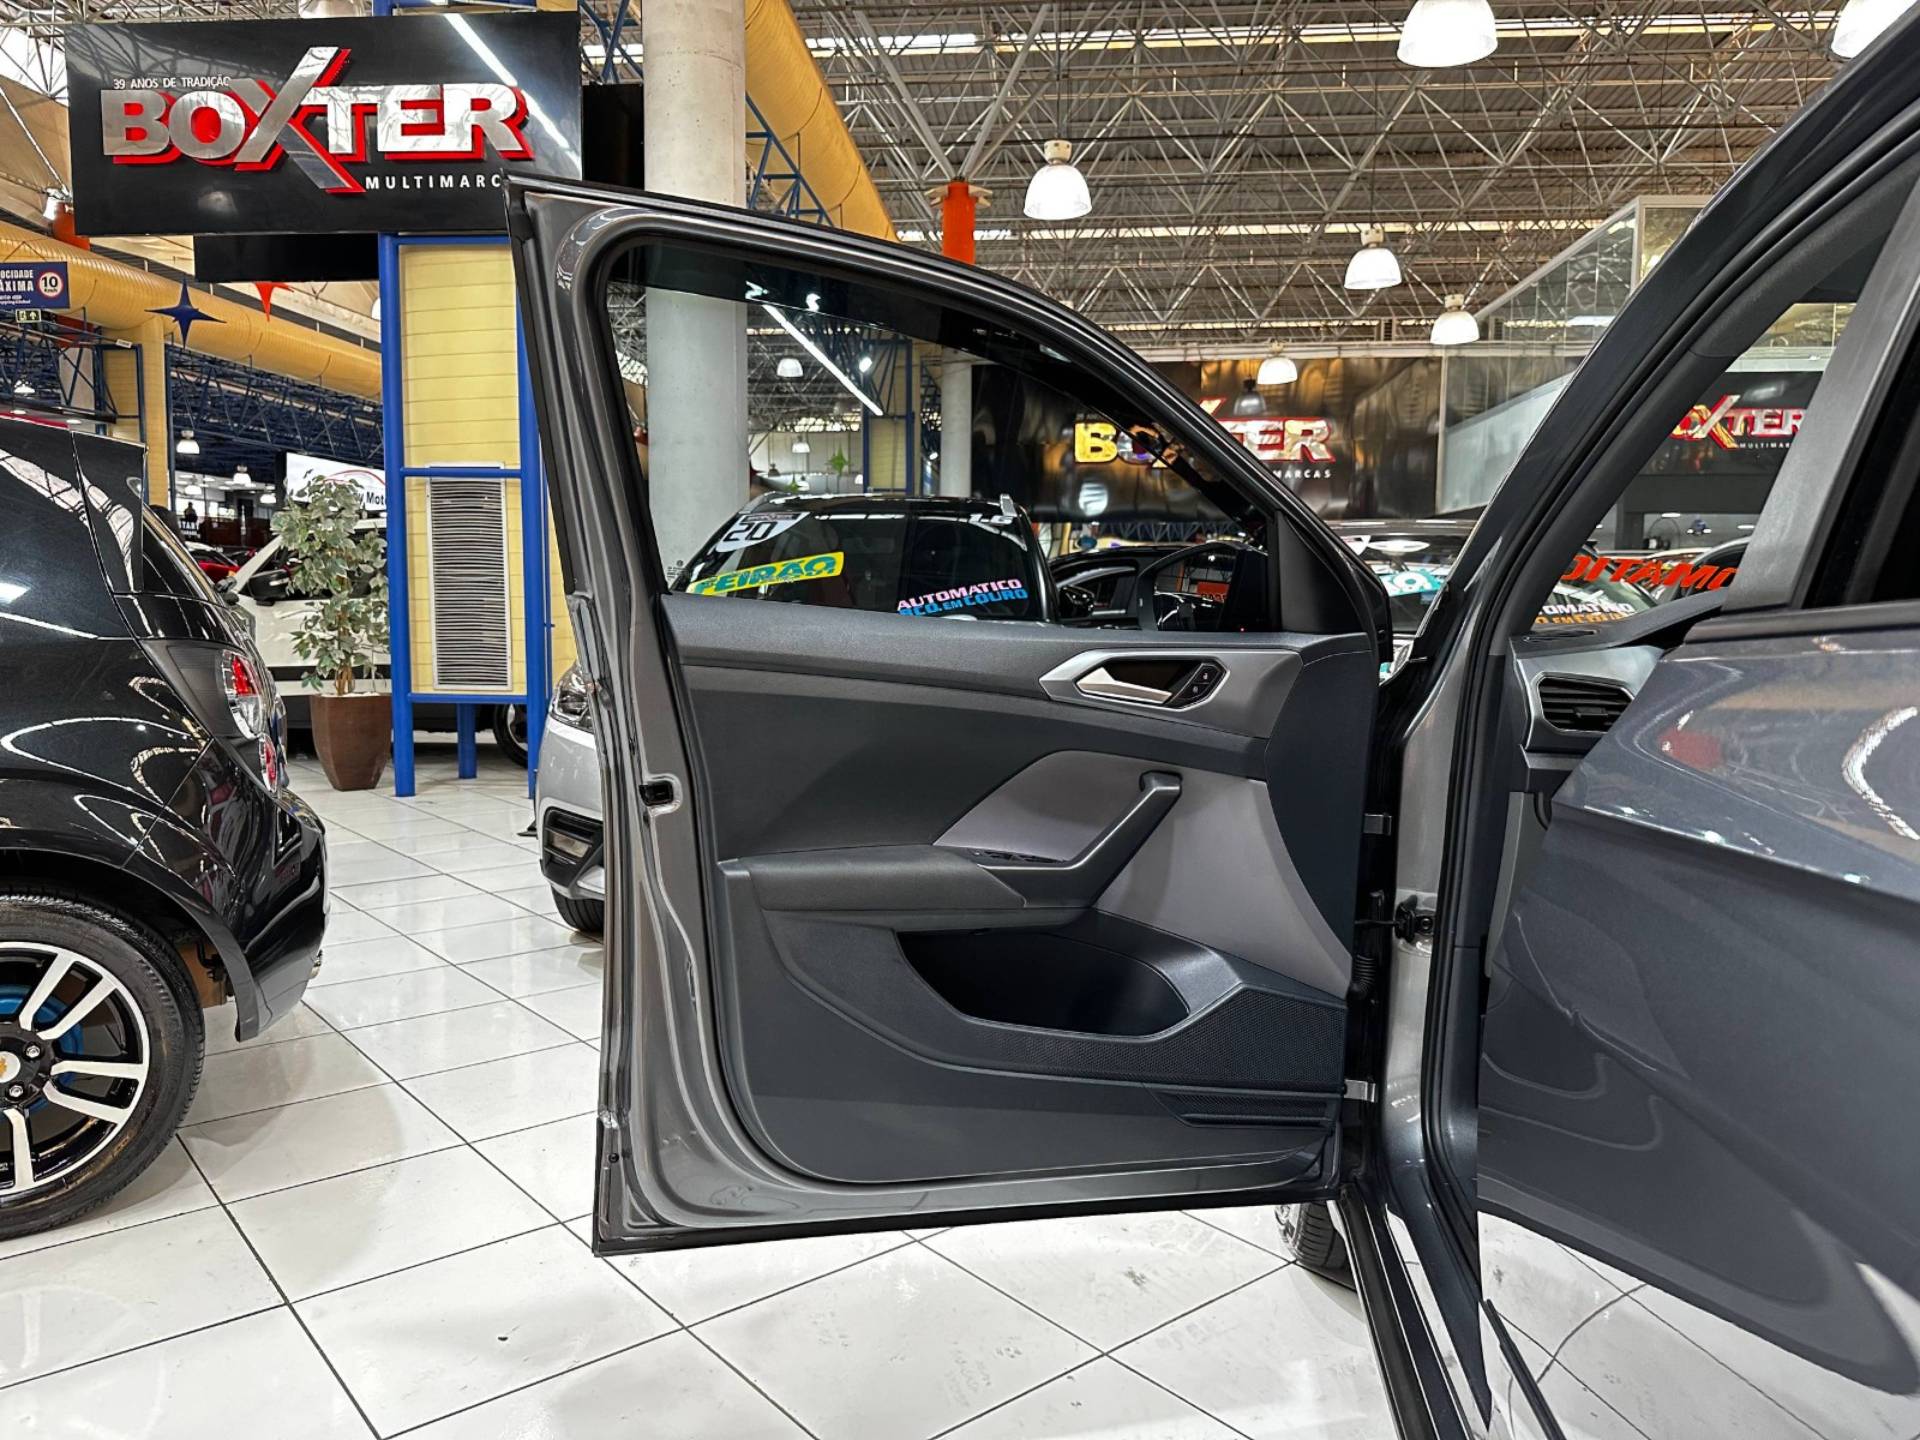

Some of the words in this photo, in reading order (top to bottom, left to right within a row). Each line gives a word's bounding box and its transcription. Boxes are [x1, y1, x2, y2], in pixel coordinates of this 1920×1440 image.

[113, 78, 126, 89] 39
[130, 77, 159, 89] ANOS
[162, 77, 177, 88] DE
[181, 74, 231, 90] TRADIÇÃO
[101, 46, 533, 192] BOXTER
[41, 276, 59, 288] 10
[722, 521, 778, 543] 20
[898, 578, 1024, 611] AUTOMATICO
[943, 599, 964, 611] EM
[964, 588, 1029, 606] COURO
